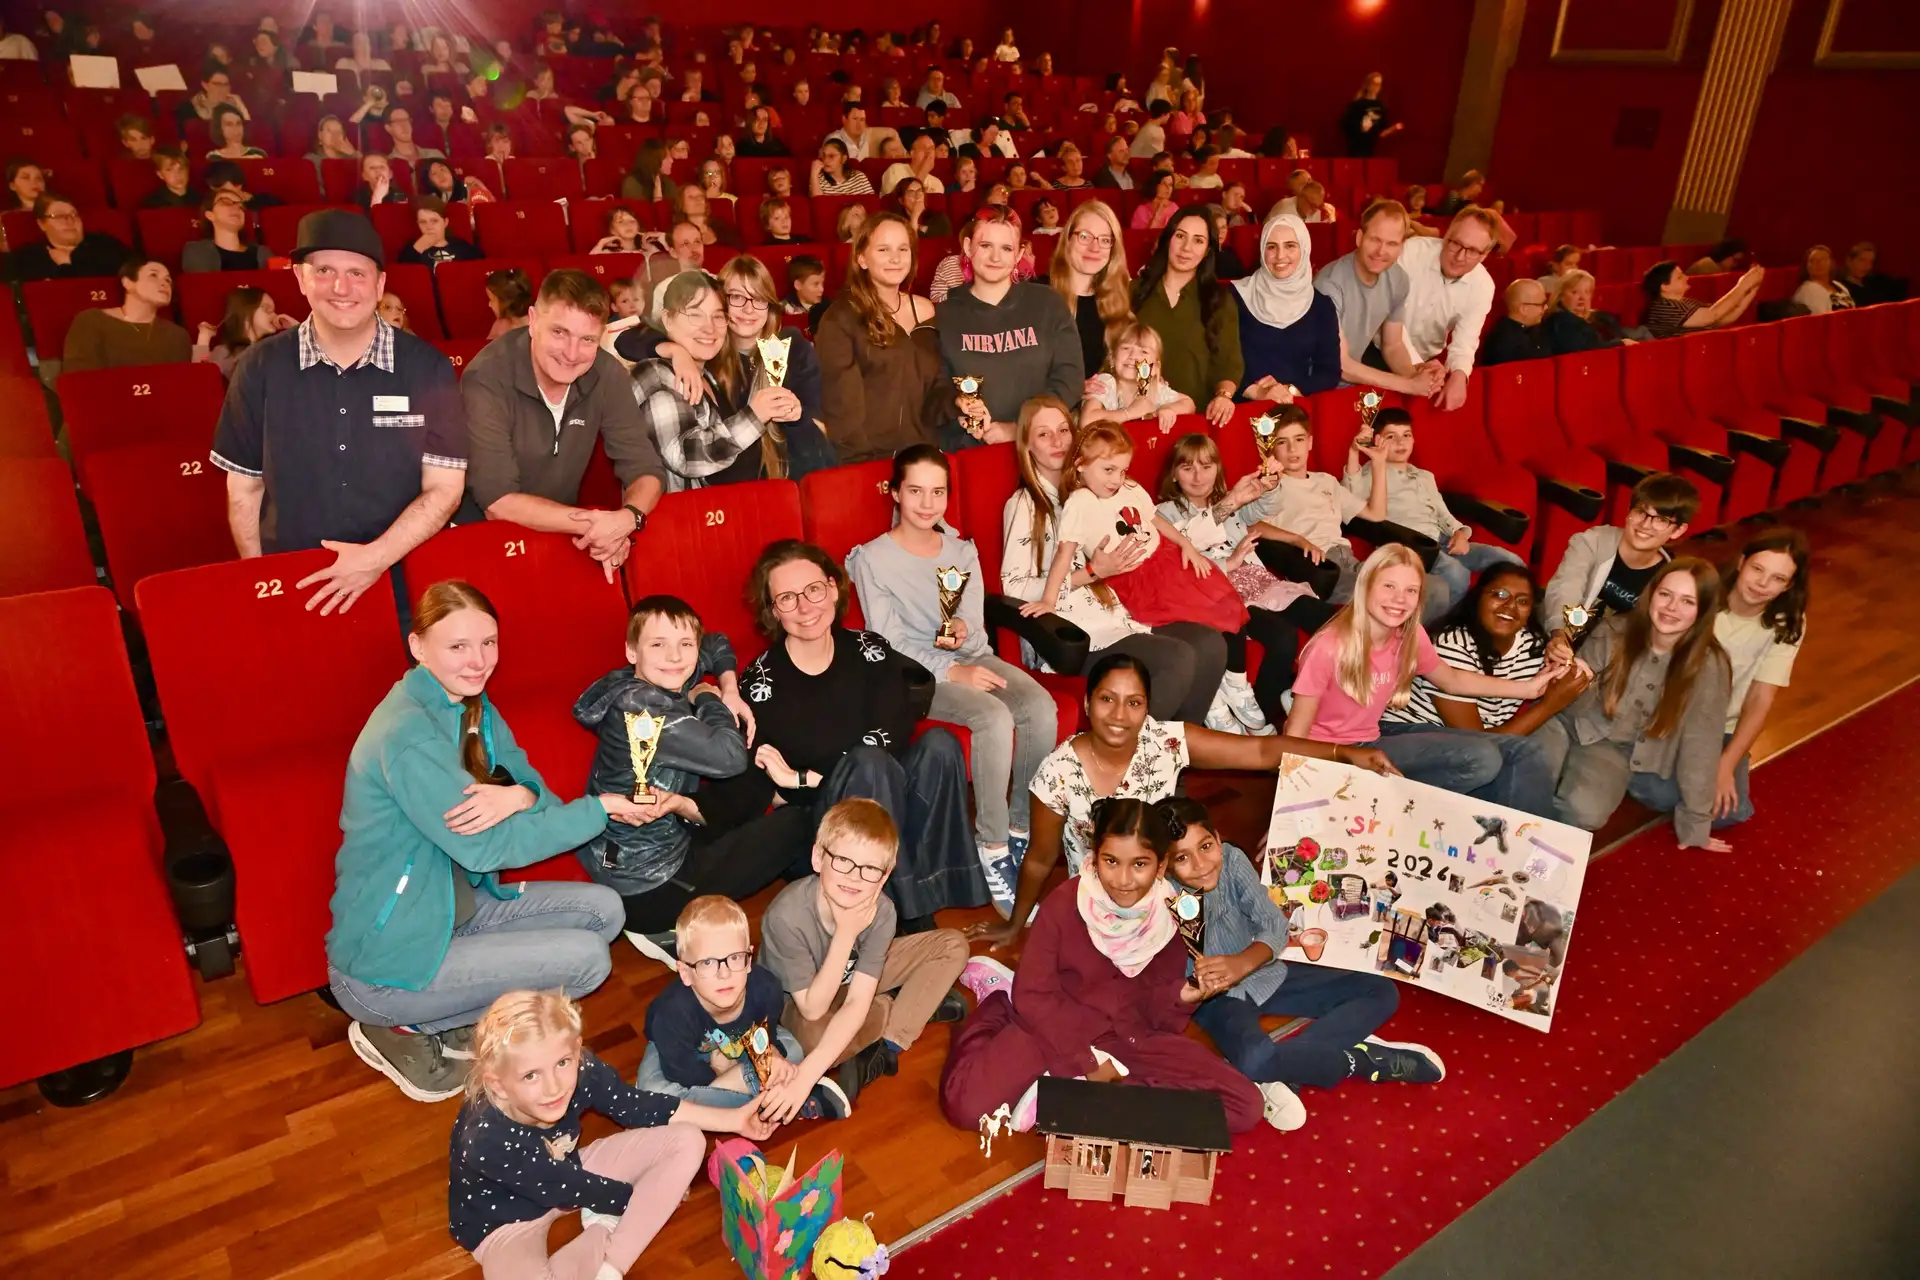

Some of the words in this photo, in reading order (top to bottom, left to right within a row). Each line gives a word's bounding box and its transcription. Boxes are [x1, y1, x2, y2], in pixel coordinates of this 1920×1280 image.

[594, 265, 605, 274] 18
[90, 290, 107, 300] 22
[961, 326, 1039, 354] NIRVANA
[132, 383, 152, 396] 22
[1147, 436, 1158, 450] 17
[180, 460, 203, 476] 22
[876, 480, 890, 495] 19
[705, 509, 725, 527] 20
[504, 539, 526, 558] 21
[254, 578, 284, 599] 22
[1350, 815, 1395, 837] Sri
